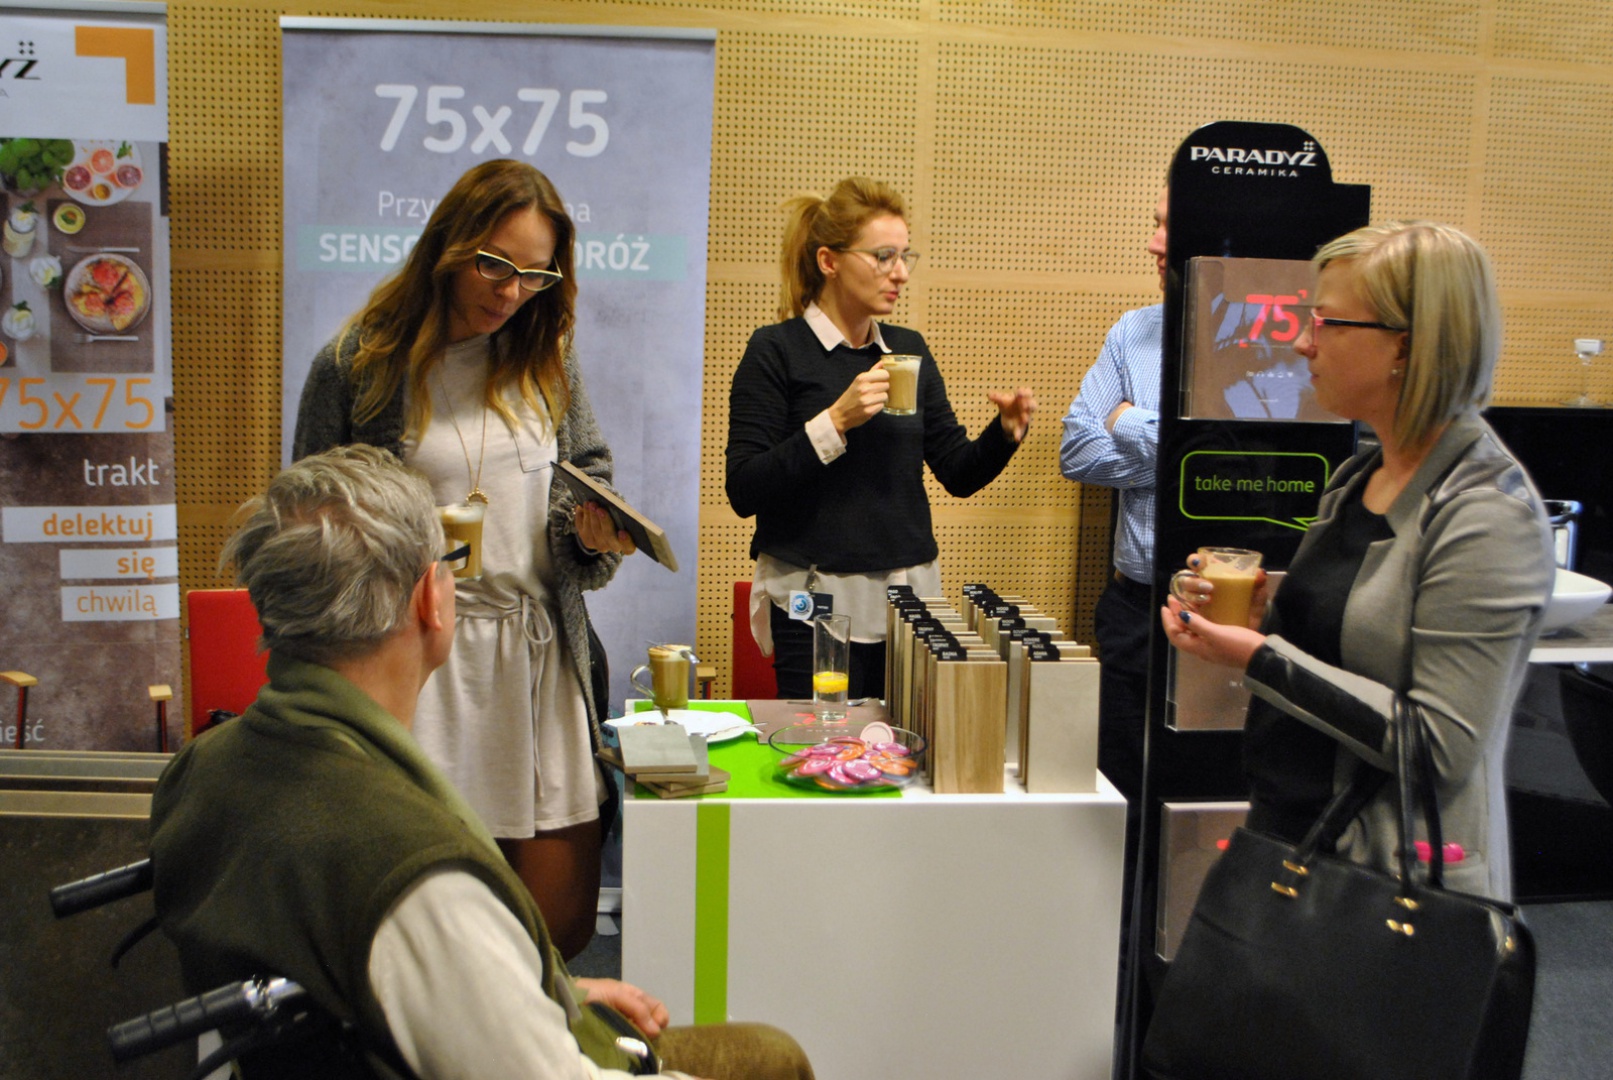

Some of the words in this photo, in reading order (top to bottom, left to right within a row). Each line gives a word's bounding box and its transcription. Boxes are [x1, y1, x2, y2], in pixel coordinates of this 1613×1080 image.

[374, 83, 610, 158] 75x75
[1211, 166, 1299, 178] CERAMIKA
[378, 189, 437, 225] Przy
[319, 233, 421, 263] SENS
[574, 233, 650, 271] RÓŻ
[1246, 294, 1300, 342] 75
[83, 456, 160, 486] trakt
[1194, 474, 1232, 491] take
[1236, 478, 1264, 491] me
[1266, 475, 1315, 493] home
[42, 512, 153, 541] delektuj
[117, 551, 156, 579] się
[77, 589, 159, 616] chwilą
